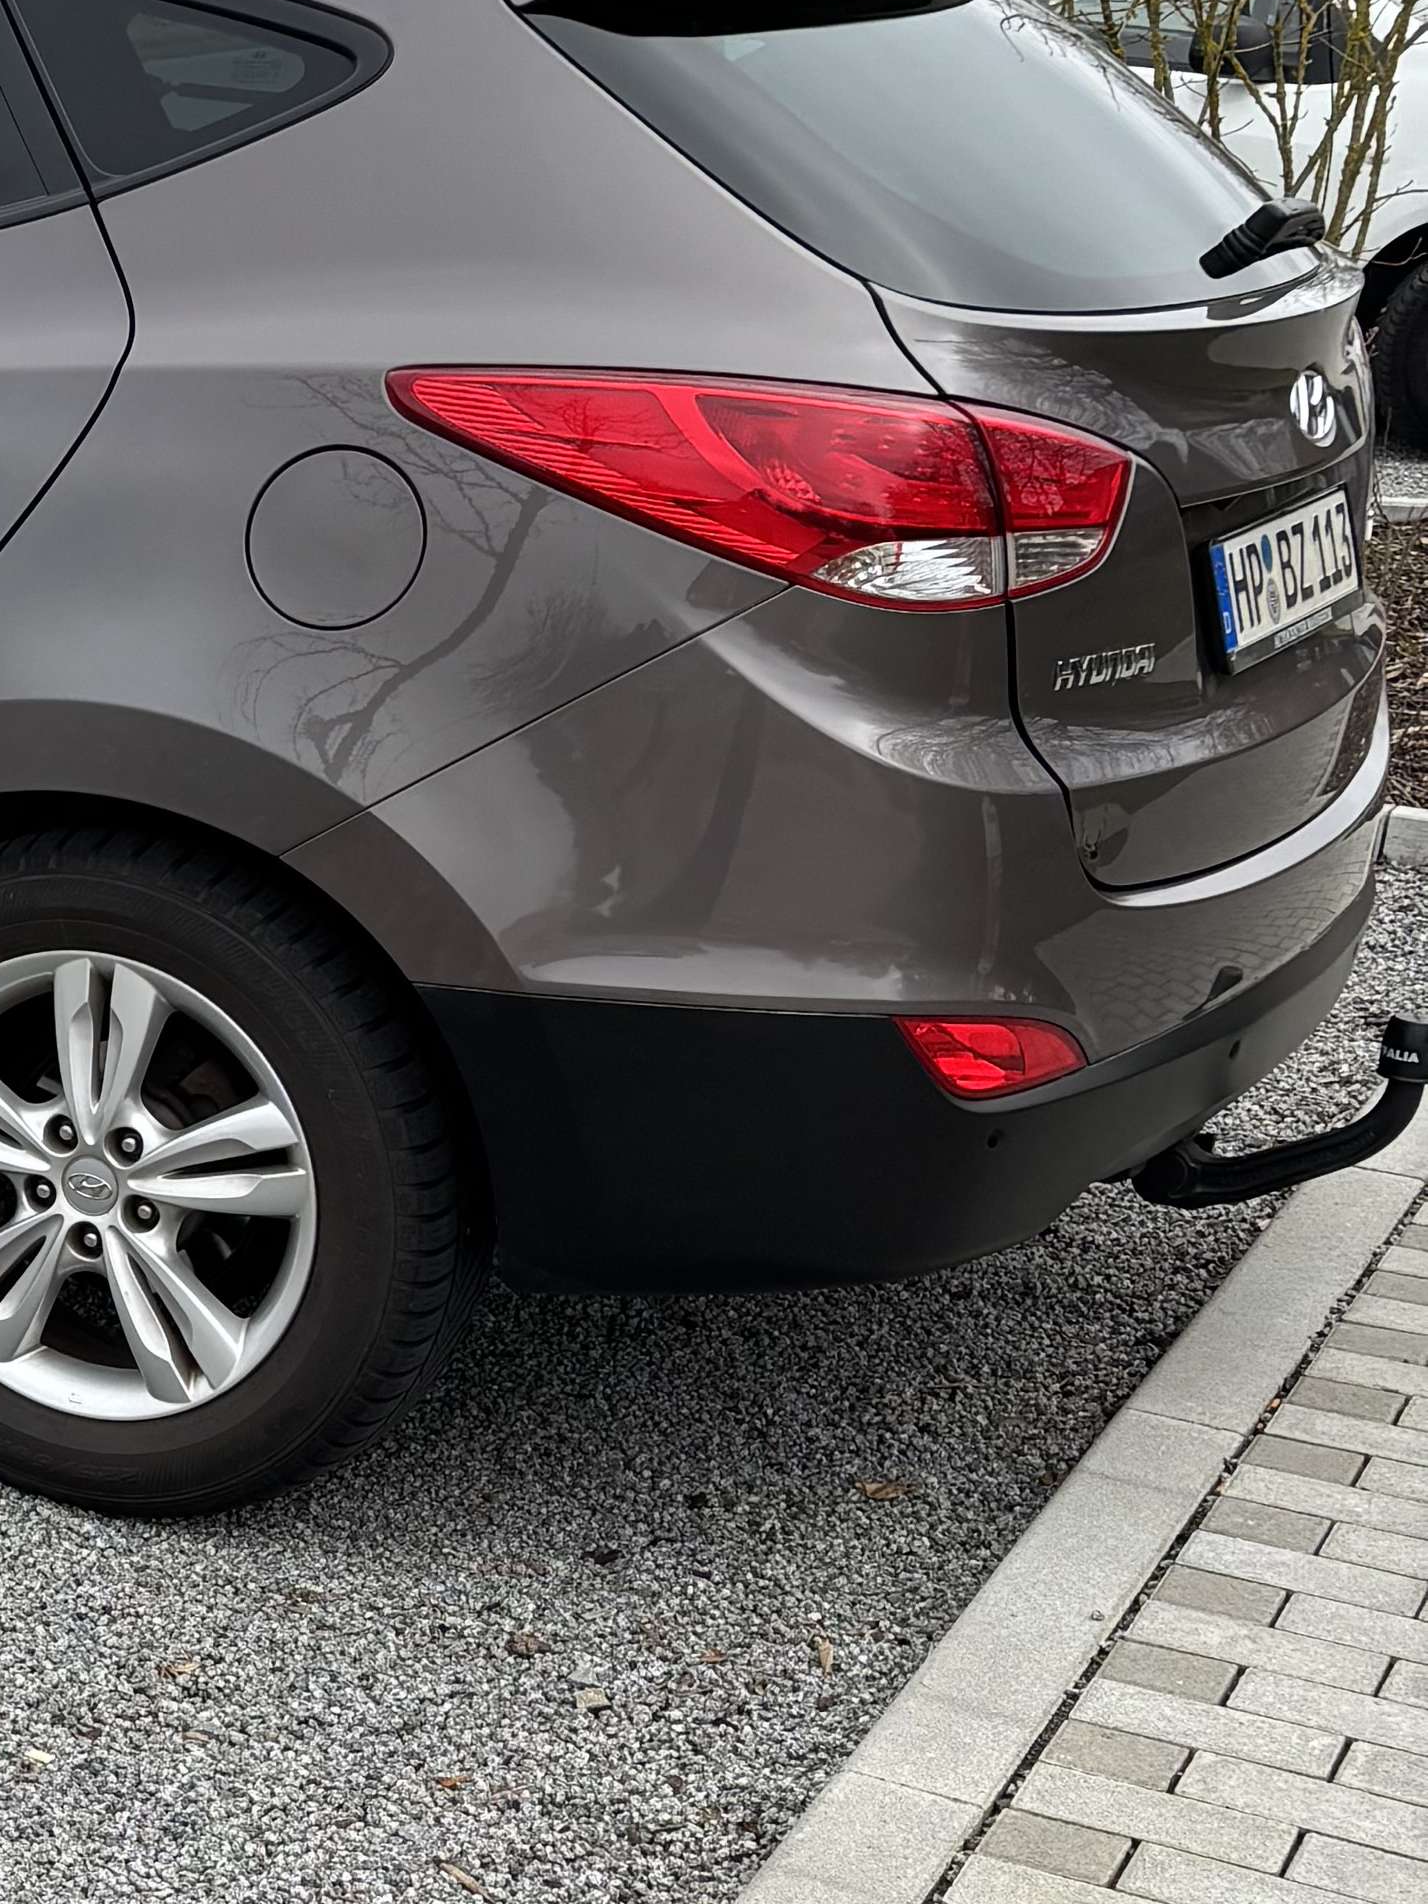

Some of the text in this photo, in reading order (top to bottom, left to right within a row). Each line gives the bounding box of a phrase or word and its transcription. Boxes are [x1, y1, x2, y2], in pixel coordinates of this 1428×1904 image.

[1229, 542, 1264, 634] HP
[1275, 521, 1315, 610] BZ
[1311, 502, 1353, 593] 113
[1222, 611, 1233, 635] D
[1053, 643, 1156, 692] HYUNDAI
